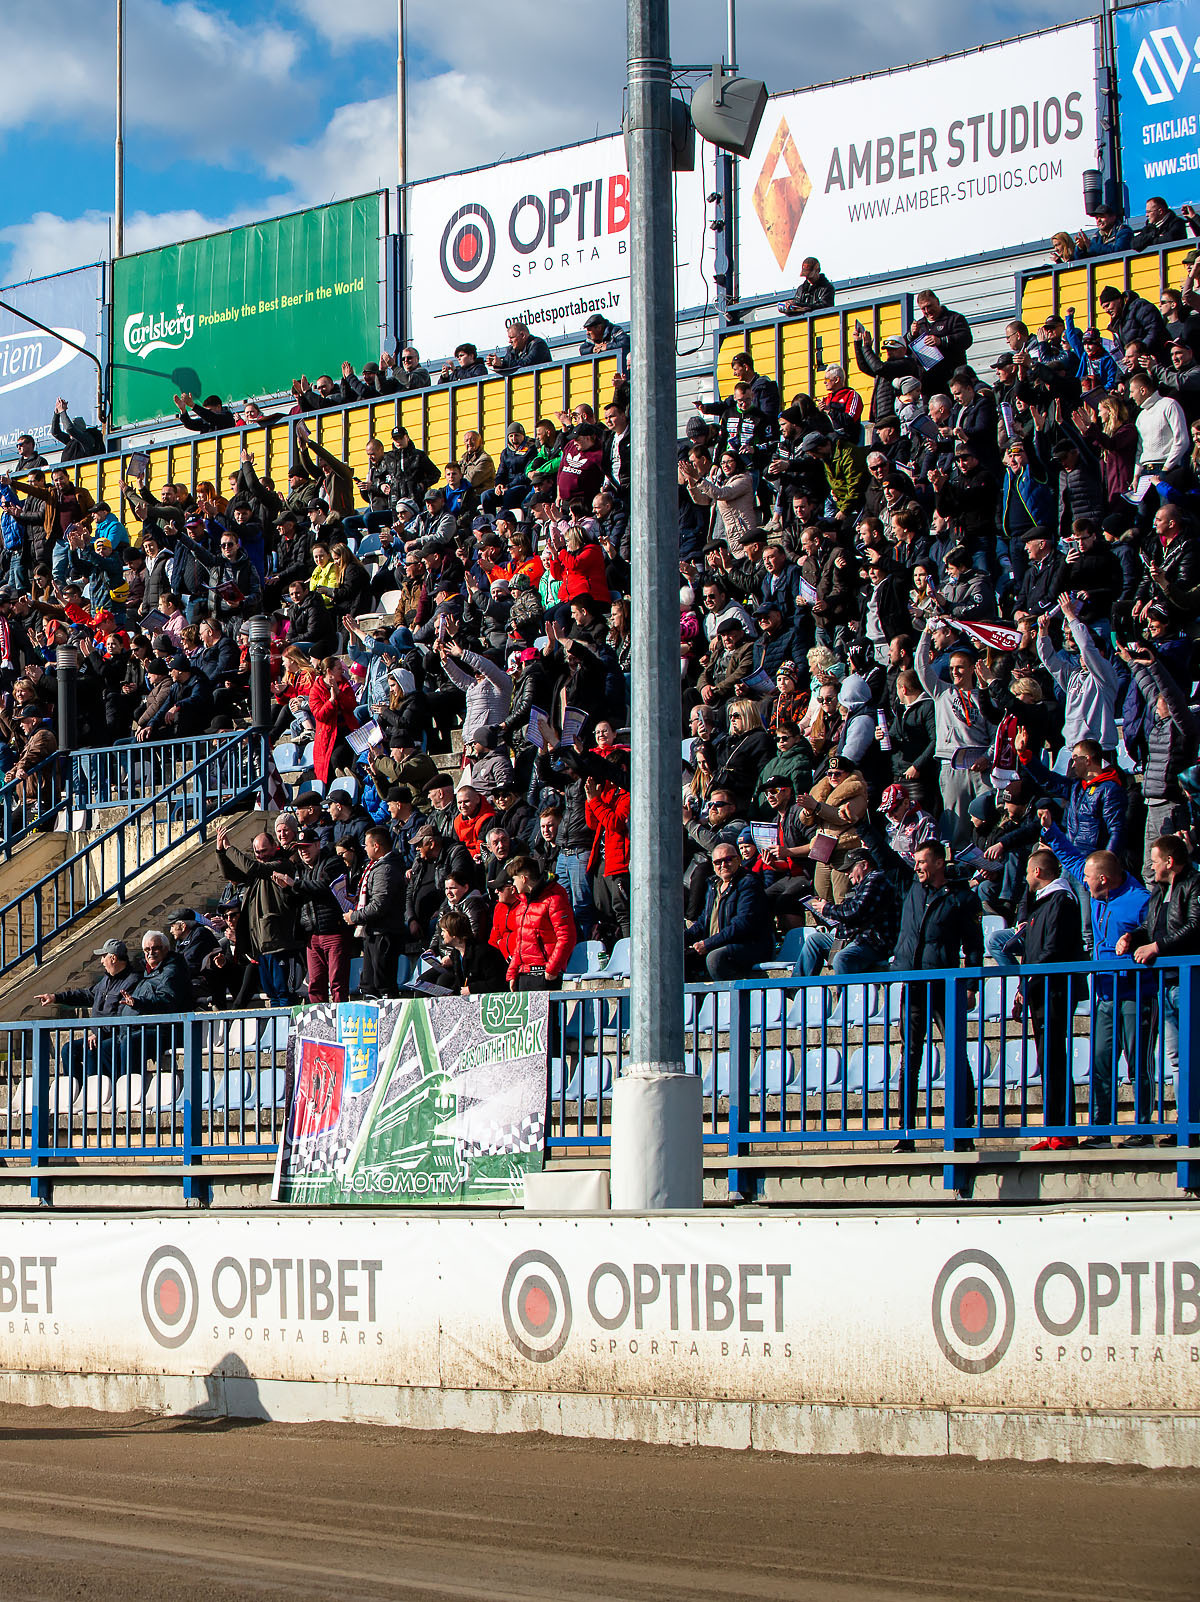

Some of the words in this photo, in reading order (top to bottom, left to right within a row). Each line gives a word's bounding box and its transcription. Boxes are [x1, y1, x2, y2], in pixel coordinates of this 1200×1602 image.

[824, 126, 937, 194] AMBER
[947, 91, 1083, 168] STUDIOS
[1142, 115, 1197, 145] STACIJAS
[848, 159, 1063, 223] WWW.AMBER-STUDIOS.COM
[508, 174, 631, 255] OPTIB
[512, 246, 600, 278] SPORTA
[198, 309, 240, 328] Probably
[241, 303, 257, 318] the
[258, 297, 279, 314] Best
[280, 293, 304, 309] Beer
[304, 290, 314, 303] in
[315, 286, 332, 301] the
[334, 277, 364, 296] World
[124, 305, 195, 354] Carlsberg
[486, 991, 524, 1028] 52
[487, 1036, 502, 1063] THE
[503, 1020, 543, 1061] TRACK
[341, 1172, 463, 1194] LOKOMOTIV
[211, 1256, 383, 1323] OPTIBET
[588, 1262, 792, 1333] OPTIBET
[8, 1315, 61, 1336] BĀRS
[212, 1326, 305, 1343] SPORTA
[322, 1326, 385, 1346] BĀRS
[590, 1338, 700, 1358] SPORTA
[721, 1338, 793, 1359] BĀRS
[1035, 1345, 1164, 1364] SPORTA
